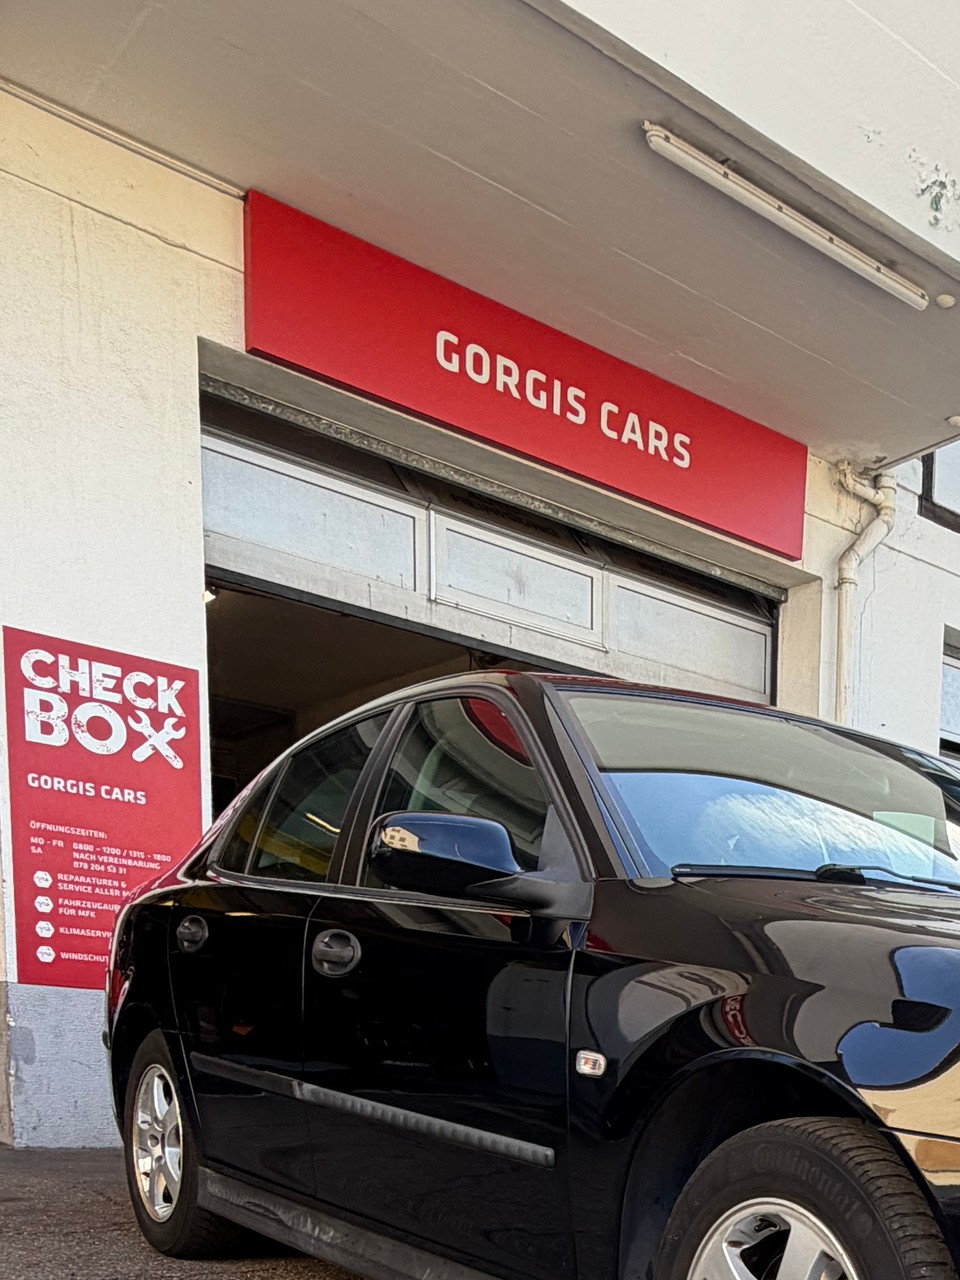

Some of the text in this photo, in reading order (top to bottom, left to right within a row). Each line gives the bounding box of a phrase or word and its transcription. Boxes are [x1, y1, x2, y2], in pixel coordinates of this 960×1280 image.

[436, 331, 691, 469] GORGIS CARS
[20, 649, 186, 718] CHECK
[23, 687, 187, 770] BOX
[27, 773, 146, 805] GORGIS CARS
[29, 820, 108, 839] ÖFFNUNGSZEITEN:
[30, 836, 45, 845] MO
[52, 839, 64, 848] FR
[102, 846, 121, 855] 1200
[30, 846, 161, 870] SA NACH VEREINBARUNG
[57, 873, 119, 887] REPARATUREN
[57, 882, 93, 894] SERVICE
[94, 887, 121, 897] ALLER
[58, 907, 76, 916] FÜR
